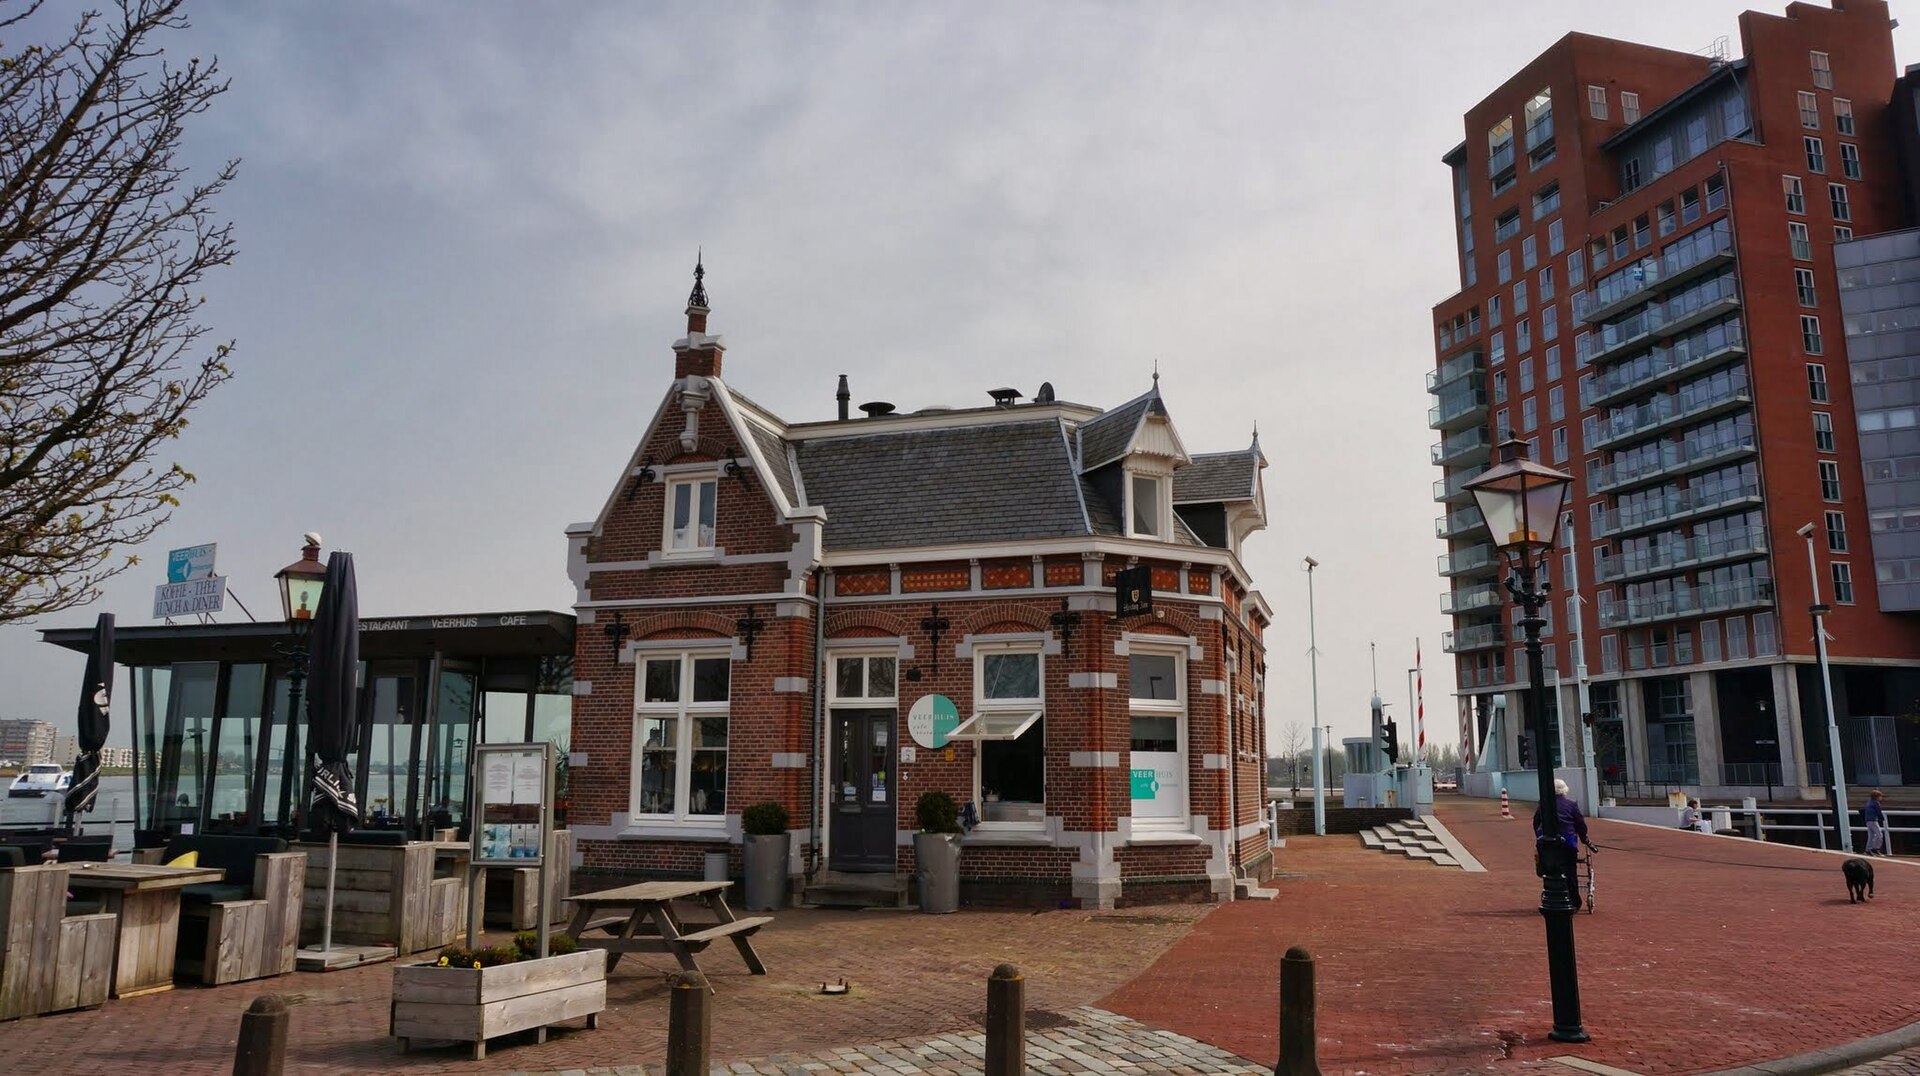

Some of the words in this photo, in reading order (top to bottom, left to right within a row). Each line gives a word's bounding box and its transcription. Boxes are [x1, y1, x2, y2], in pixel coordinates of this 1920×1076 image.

[195, 580, 217, 595] THEE
[156, 600, 181, 615] LUNCH
[192, 595, 220, 611] DINER
[358, 620, 409, 631] ESTAURANT
[431, 617, 478, 628] VEERHUIS
[500, 615, 527, 626] CAFE
